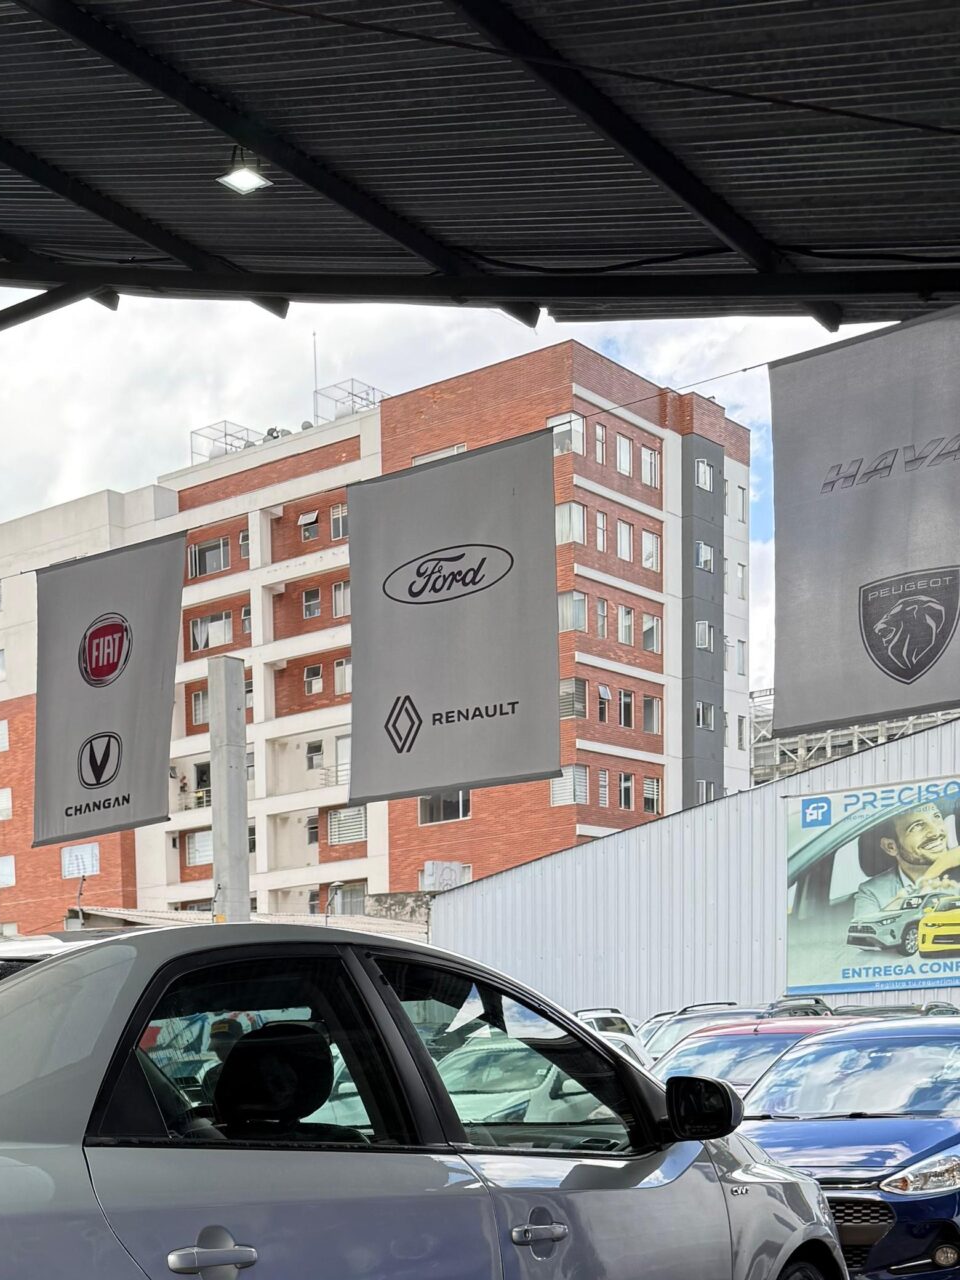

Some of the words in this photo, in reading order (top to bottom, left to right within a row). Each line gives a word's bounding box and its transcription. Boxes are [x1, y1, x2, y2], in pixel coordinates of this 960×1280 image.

[408, 552, 487, 598] Ford
[867, 576, 953, 601] PEUGEOT
[92, 632, 122, 669] FIAT
[432, 701, 519, 726] RENAULT
[65, 793, 130, 817] CHANGAN
[844, 780, 960, 812] PRECISO
[841, 964, 916, 979] ENTREGA
